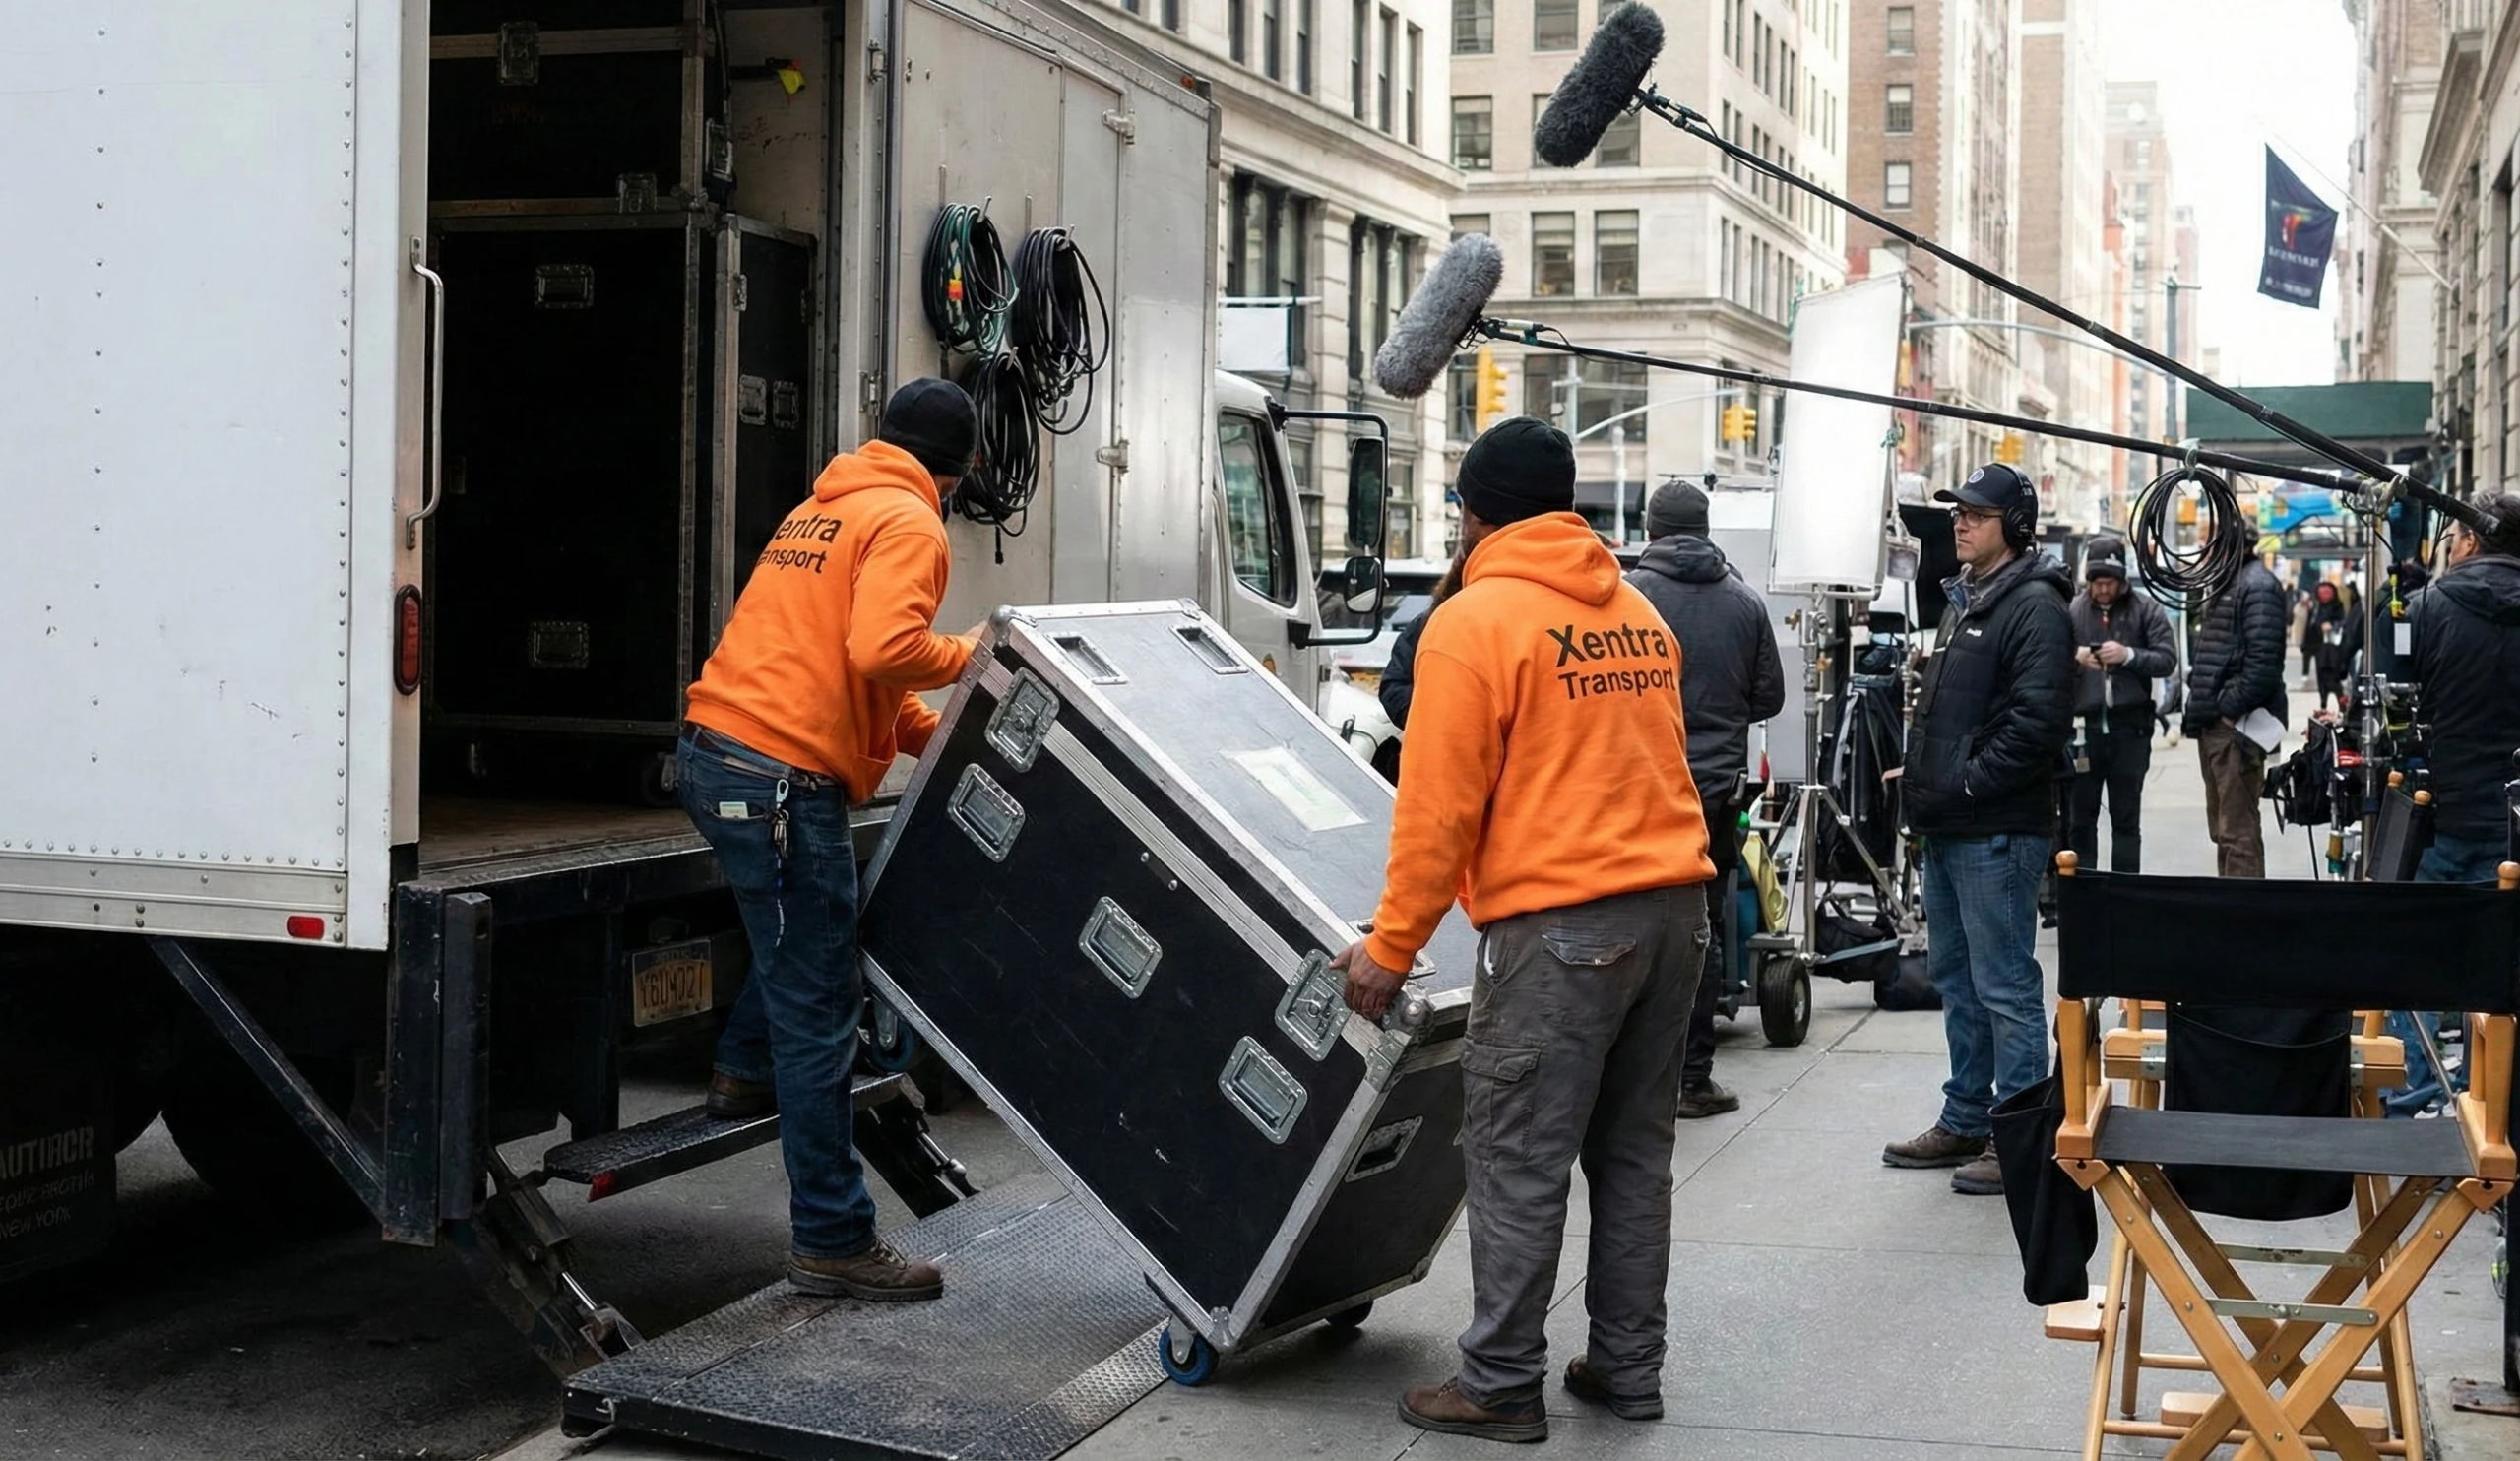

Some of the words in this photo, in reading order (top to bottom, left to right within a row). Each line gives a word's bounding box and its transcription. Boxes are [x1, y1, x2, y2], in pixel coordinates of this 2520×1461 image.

[775, 512, 843, 544] entra
[756, 548, 828, 574] ansport
[1545, 622, 1670, 668] Xentra
[1558, 666, 1676, 700] Transport
